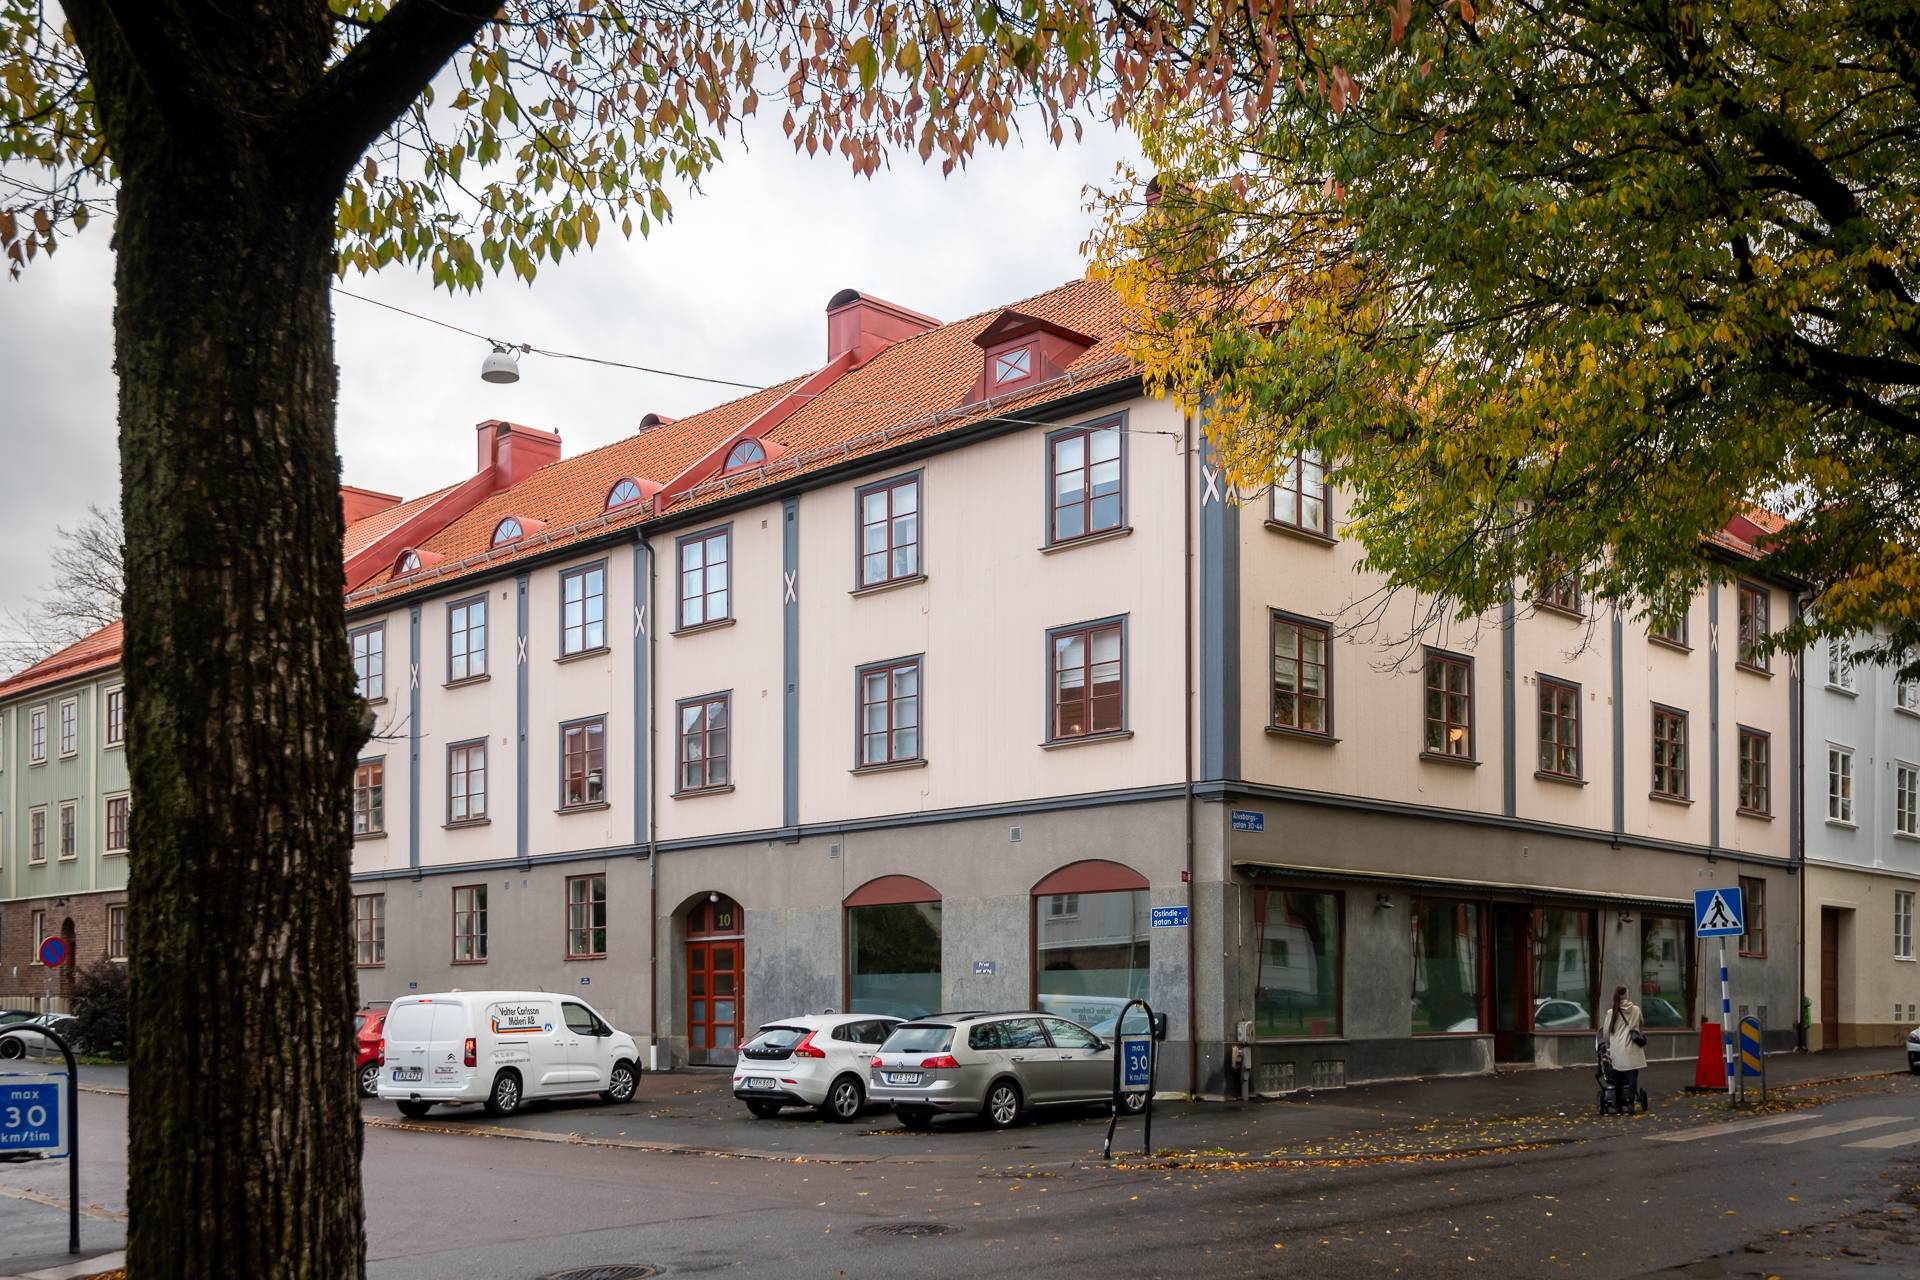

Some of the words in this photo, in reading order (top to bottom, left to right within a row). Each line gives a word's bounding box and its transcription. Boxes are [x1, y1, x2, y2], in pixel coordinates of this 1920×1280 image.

[720, 914, 730, 926] 10
[499, 1006, 516, 1015] Valter
[517, 1006, 539, 1015] Carlsson
[527, 1016, 536, 1025] AB
[1131, 1055, 1148, 1070] 30
[11, 1090, 40, 1100] max
[5, 1105, 47, 1128] 30
[1, 1131, 51, 1143] km/tim
